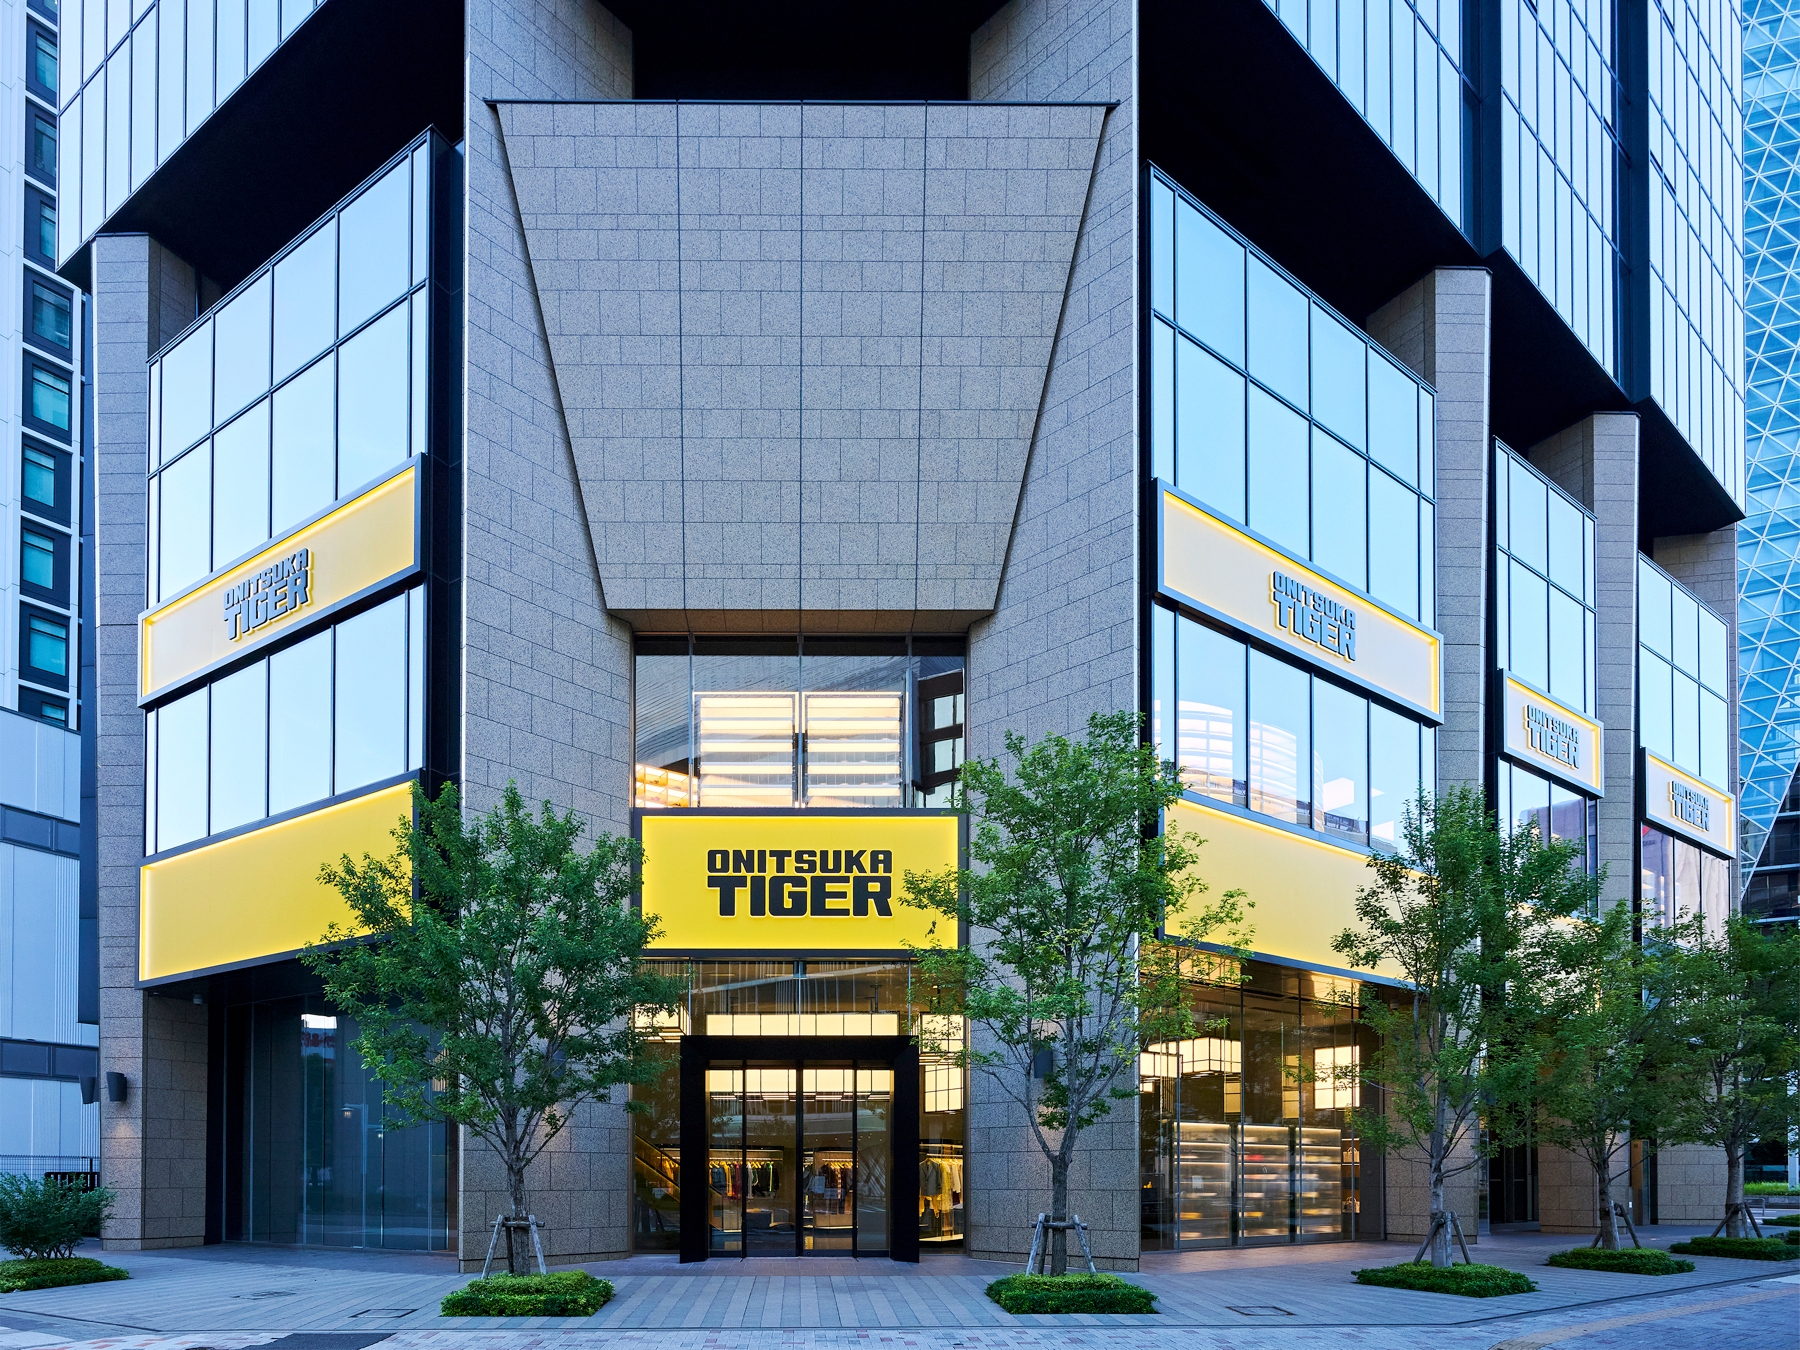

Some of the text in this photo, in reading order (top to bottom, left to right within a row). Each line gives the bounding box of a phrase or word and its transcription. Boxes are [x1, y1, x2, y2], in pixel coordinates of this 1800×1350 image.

[224, 548, 308, 610] ONITSUKA
[1273, 571, 1355, 630] ONITSUKA
[224, 569, 308, 640] TIGER
[1273, 591, 1355, 661] TIGER
[1527, 705, 1579, 744] ONITSUKA
[1527, 720, 1579, 769] TIGER
[1672, 794, 1709, 831] TIGER
[708, 850, 892, 873] ONITSUKA
[708, 876, 892, 916] TIGER
